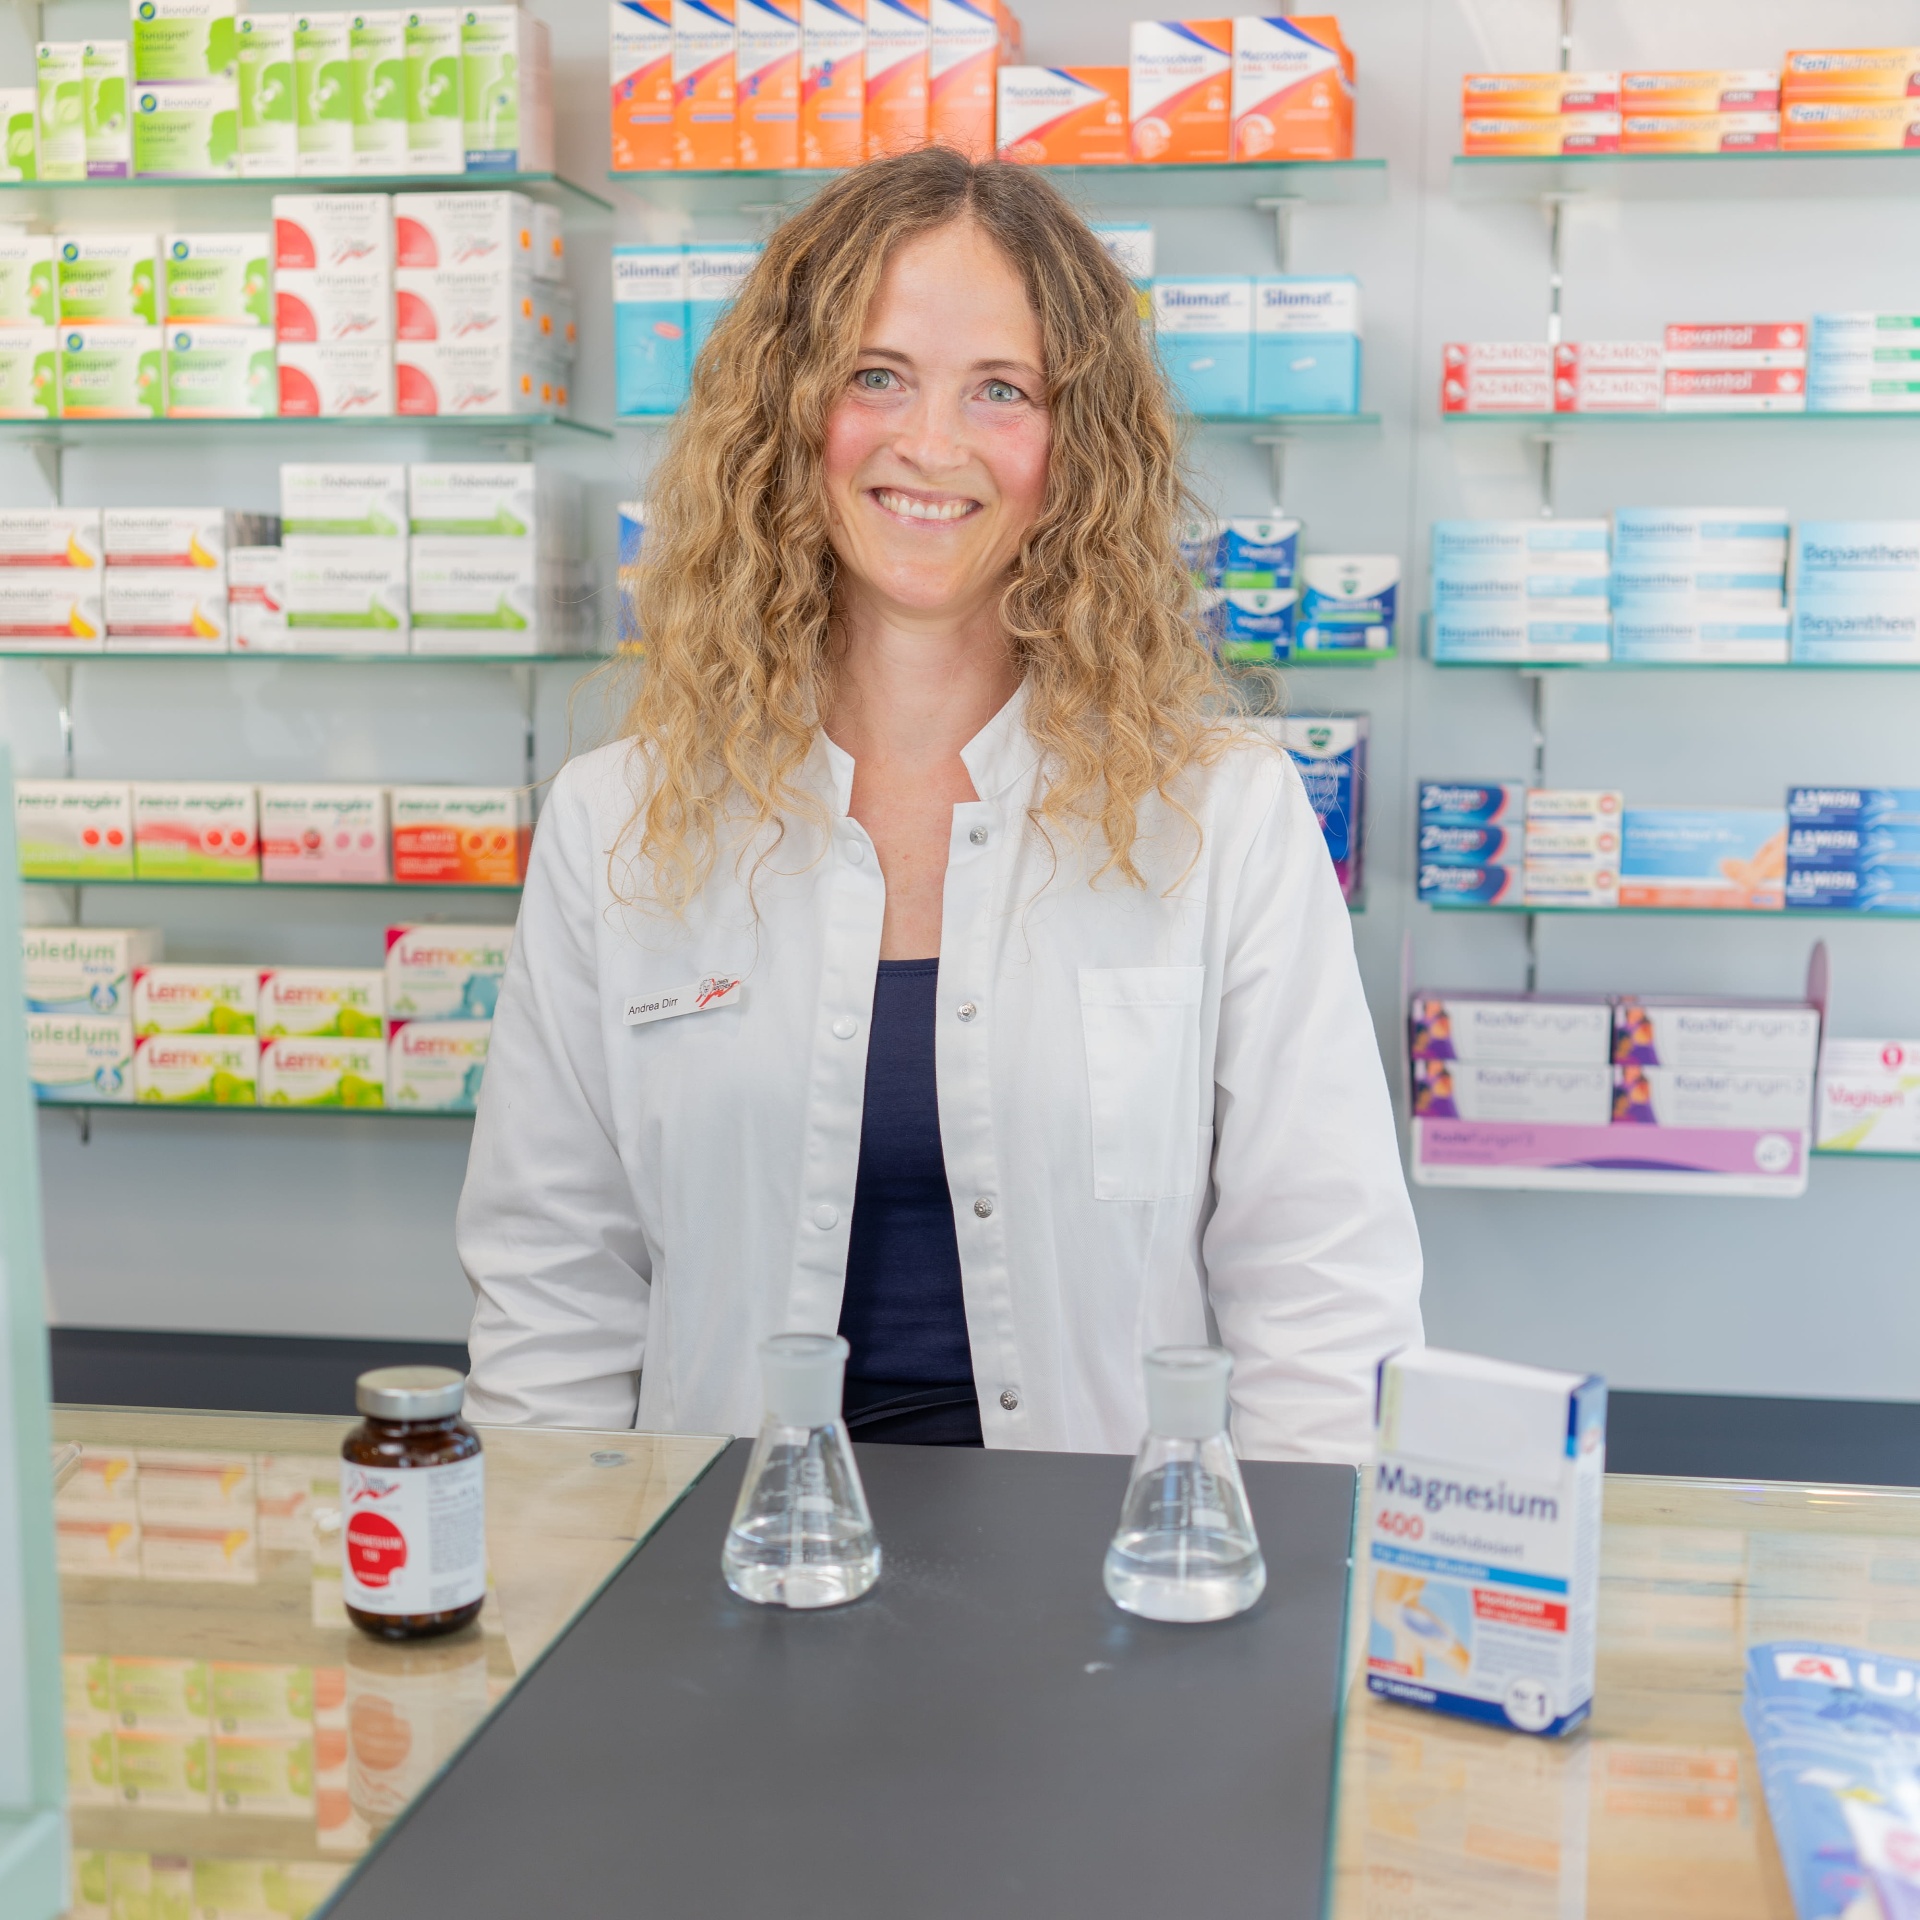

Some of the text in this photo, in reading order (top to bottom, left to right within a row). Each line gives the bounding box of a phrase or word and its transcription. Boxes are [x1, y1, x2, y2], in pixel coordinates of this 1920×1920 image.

[20, 939, 116, 963] oledum
[628, 997, 679, 1016] Andrea Dirr
[24, 1019, 120, 1044] oledum
[403, 1035, 490, 1056] Lemoci
[1376, 1463, 1560, 1522] Magnesium
[1376, 1510, 1425, 1541] 400
